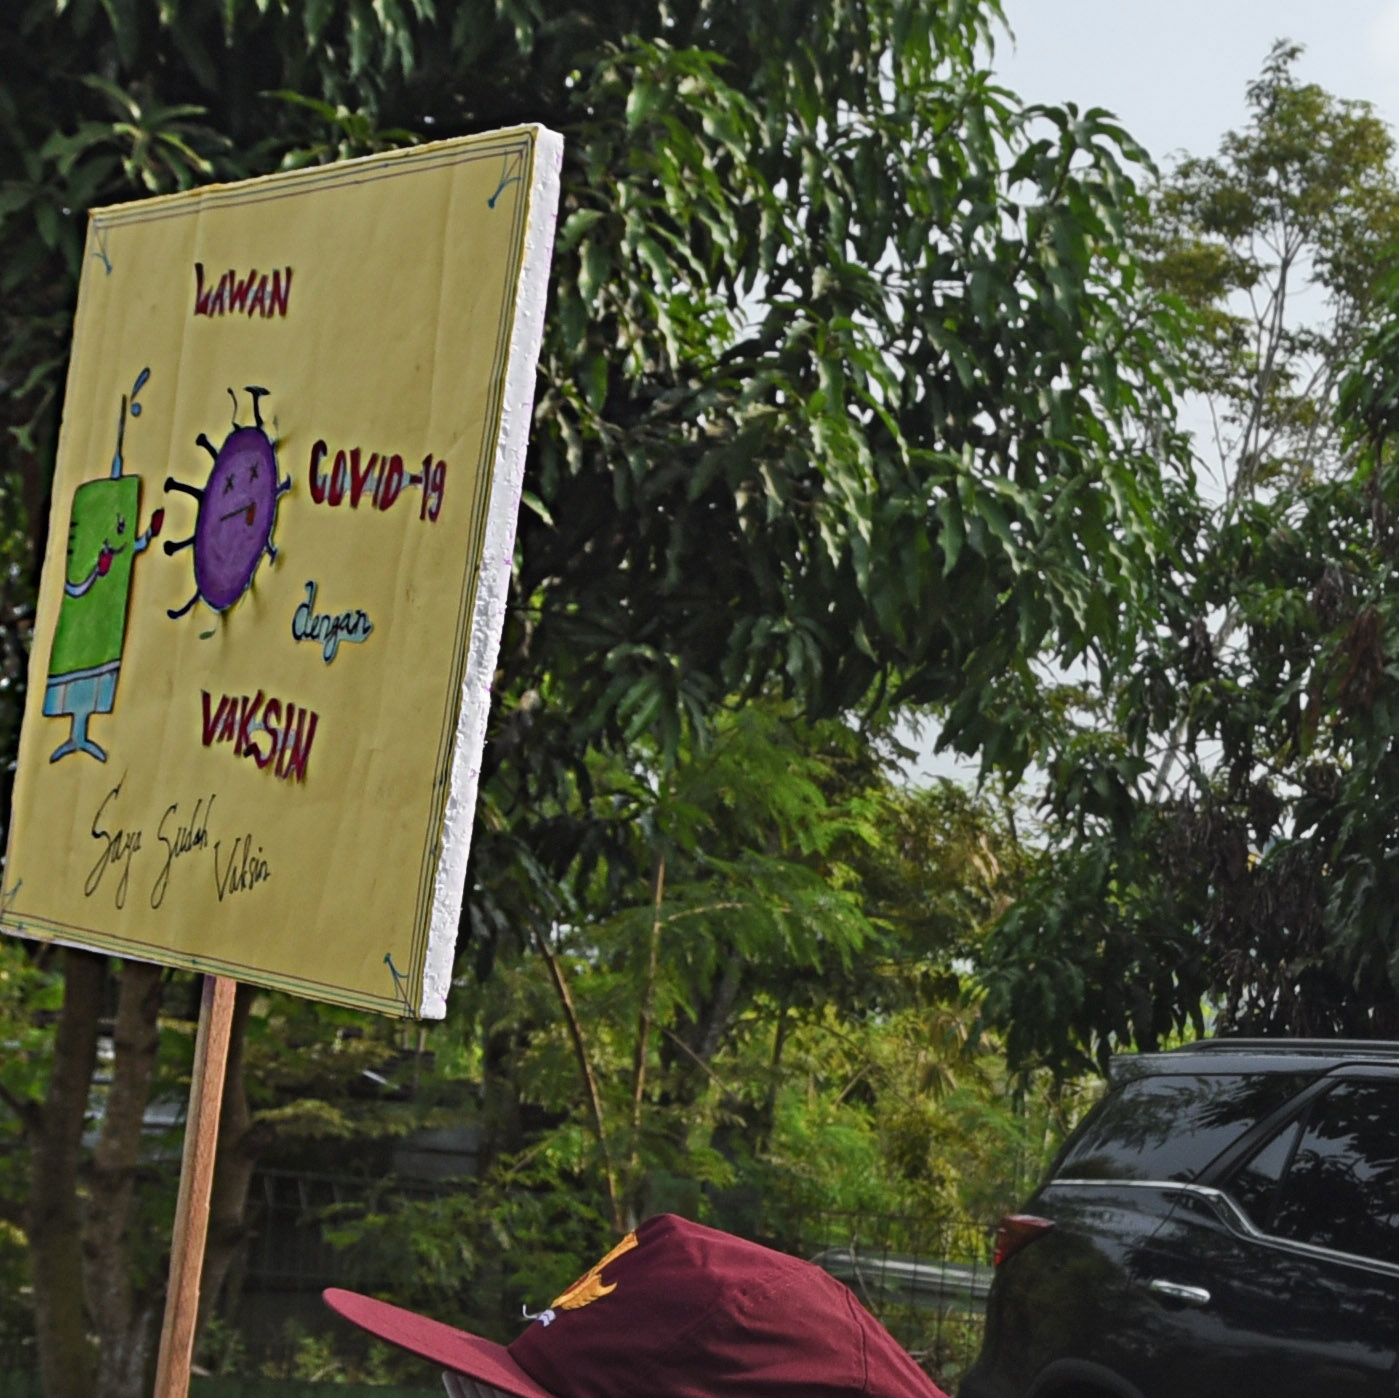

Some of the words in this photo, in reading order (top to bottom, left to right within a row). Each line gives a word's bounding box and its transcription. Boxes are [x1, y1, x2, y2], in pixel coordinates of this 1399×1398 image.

[194, 262, 292, 319] LAWAN
[309, 439, 447, 523] COVID-19
[292, 580, 372, 662] dengan
[201, 689, 319, 782] VAKSIN
[84, 768, 142, 910] Saya
[150, 793, 216, 910] Sudah
[213, 833, 271, 902] Vaksin
